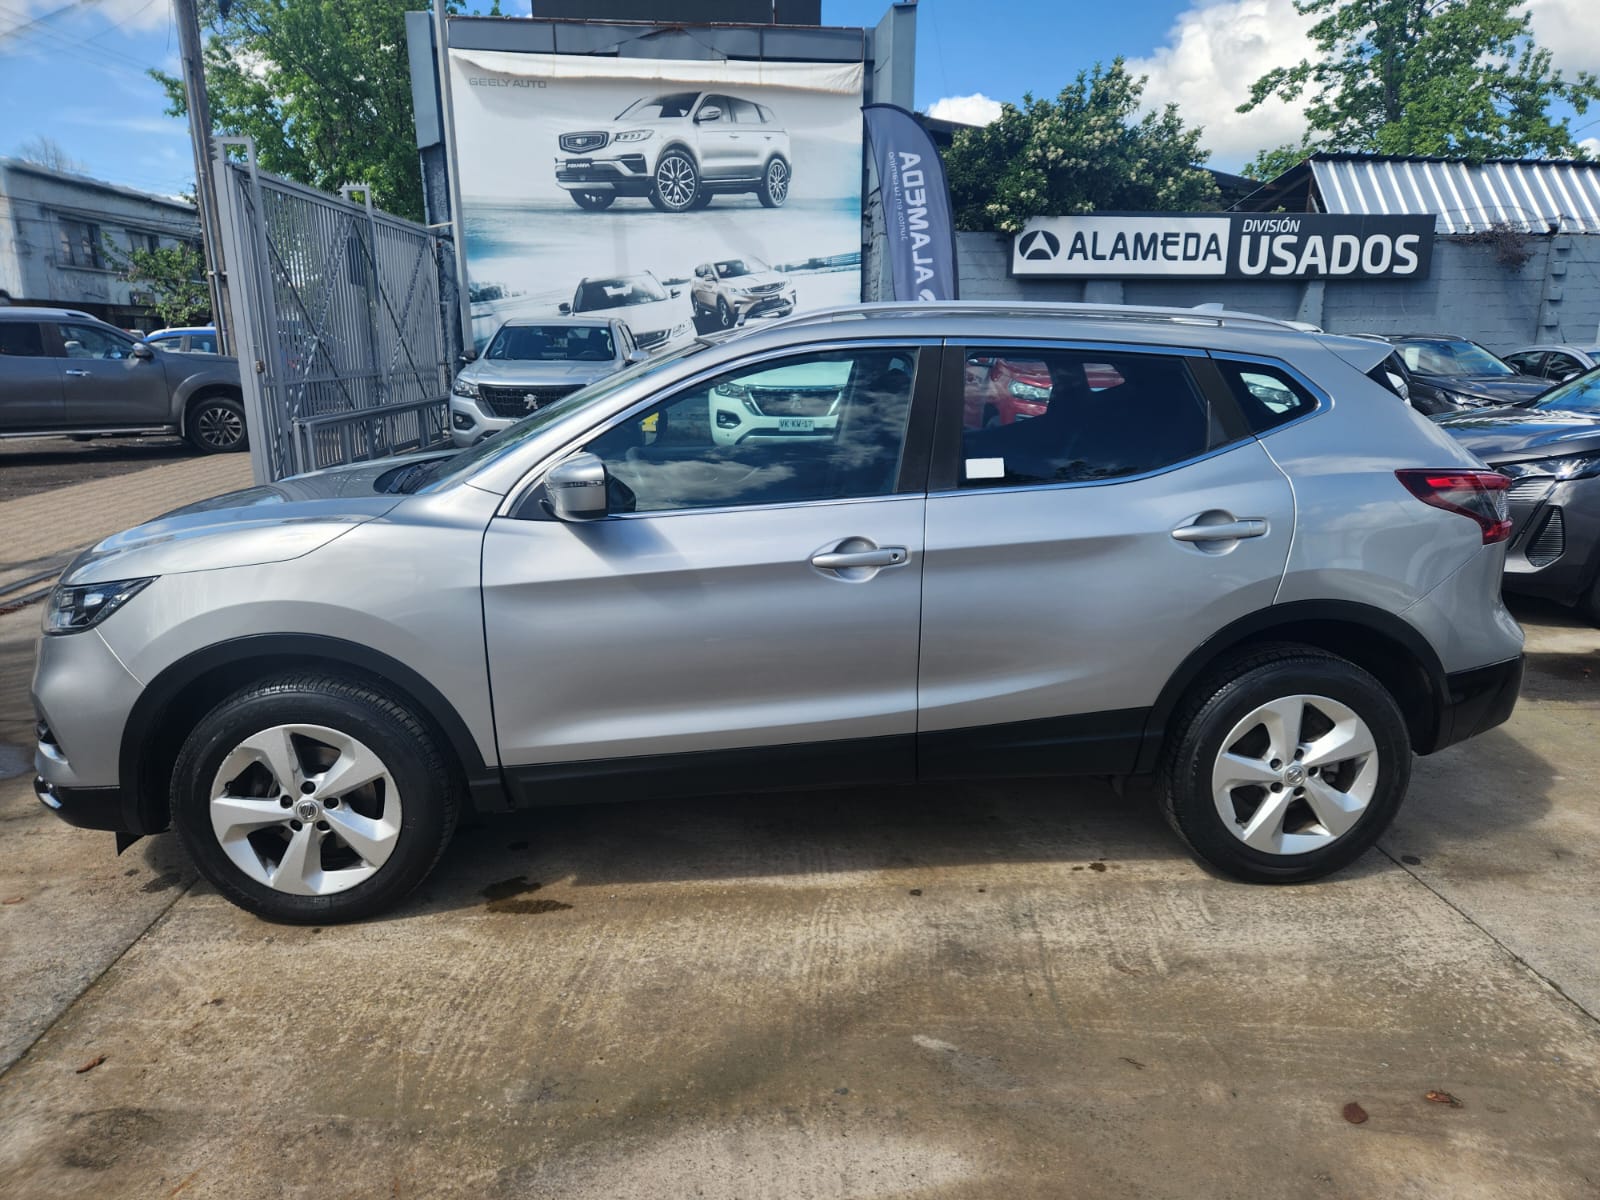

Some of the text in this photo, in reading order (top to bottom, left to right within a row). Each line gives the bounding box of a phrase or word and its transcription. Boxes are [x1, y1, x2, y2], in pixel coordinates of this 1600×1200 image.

[468, 77, 547, 88] GEELY AUTO
[1242, 216, 1301, 233] DIVISIÓN
[1067, 231, 1222, 261] ALAMEDA
[1238, 234, 1420, 275] USADOS
